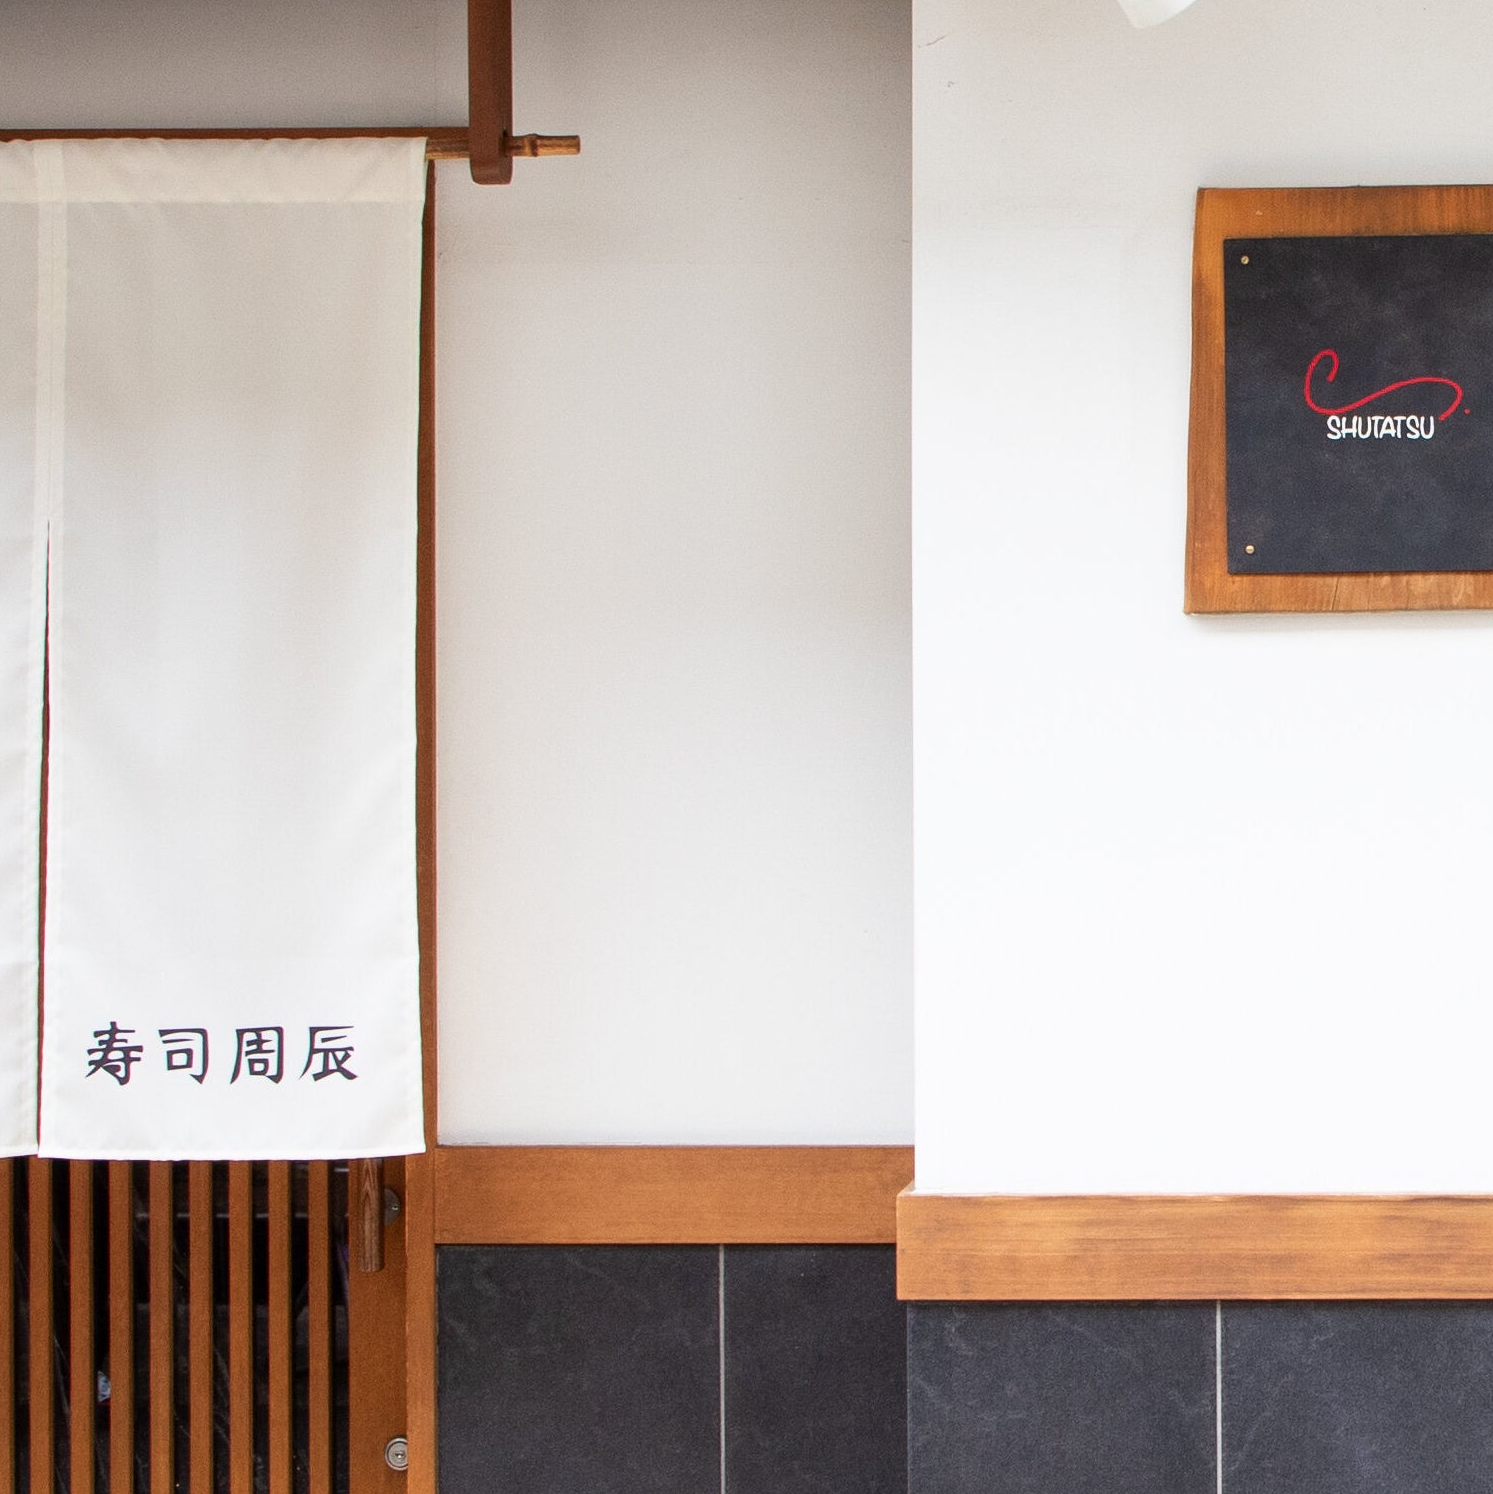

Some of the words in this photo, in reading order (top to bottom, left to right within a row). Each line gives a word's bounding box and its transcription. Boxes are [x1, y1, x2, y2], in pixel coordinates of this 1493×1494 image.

[1327, 415, 1435, 440] SHUTATSU
[84, 1020, 359, 1086] 寿司周辰
